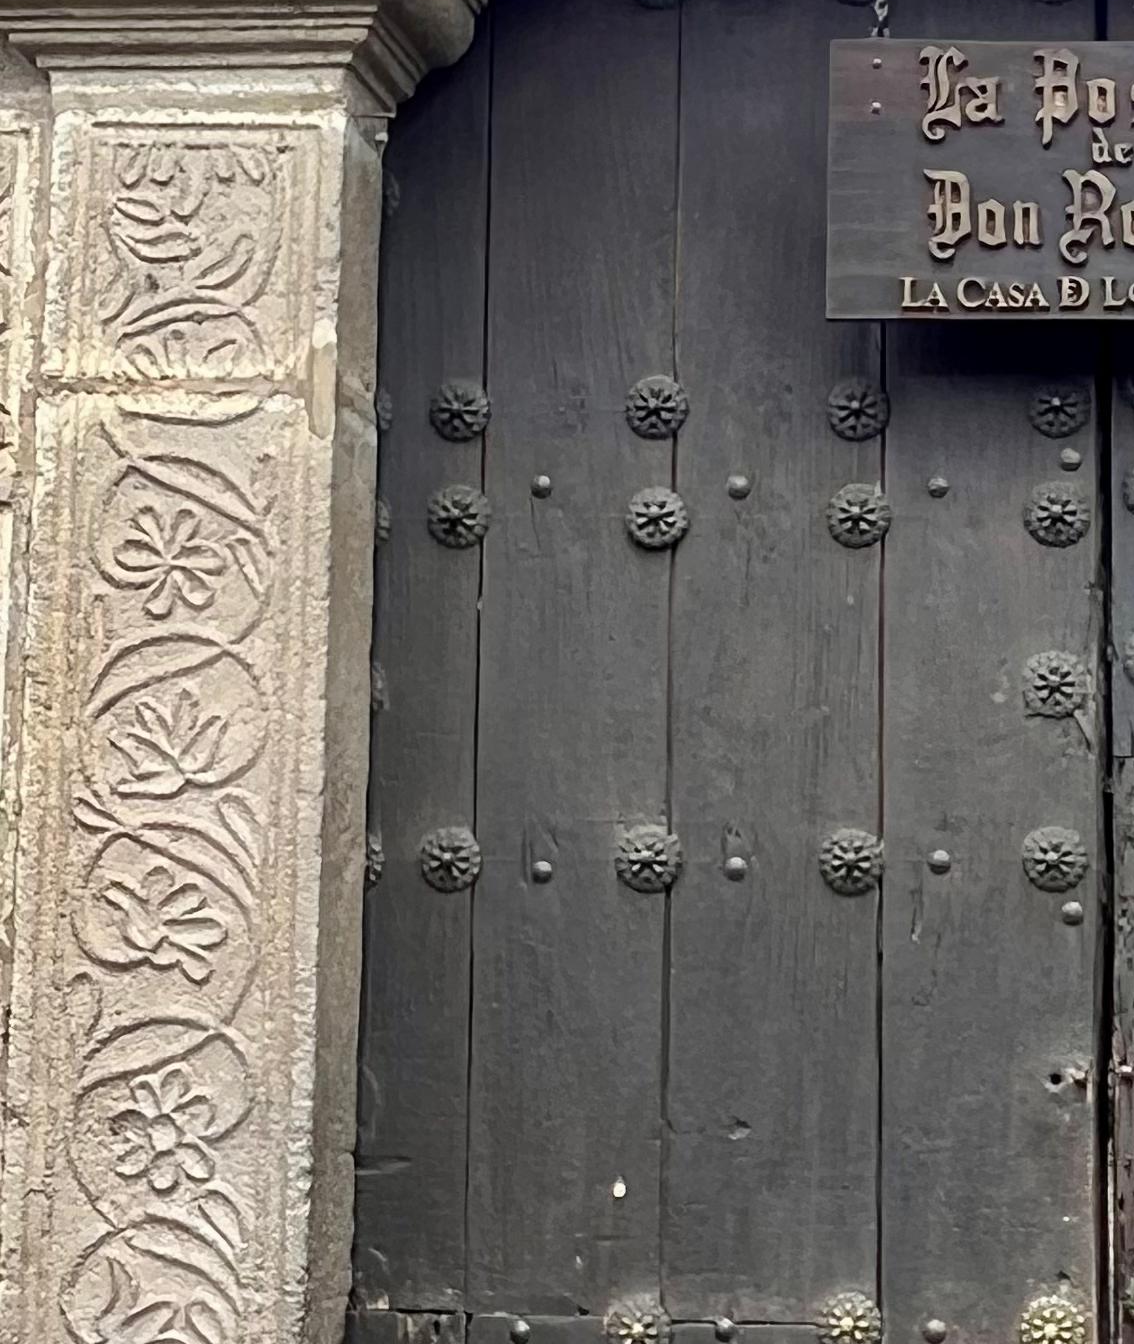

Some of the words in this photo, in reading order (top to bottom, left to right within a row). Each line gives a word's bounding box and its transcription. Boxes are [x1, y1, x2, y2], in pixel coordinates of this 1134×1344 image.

[919, 45, 1004, 142] La
[1092, 127, 1134, 164] de
[923, 168, 1042, 261] Don
[900, 276, 949, 308] LA
[956, 276, 1049, 309] CASA
